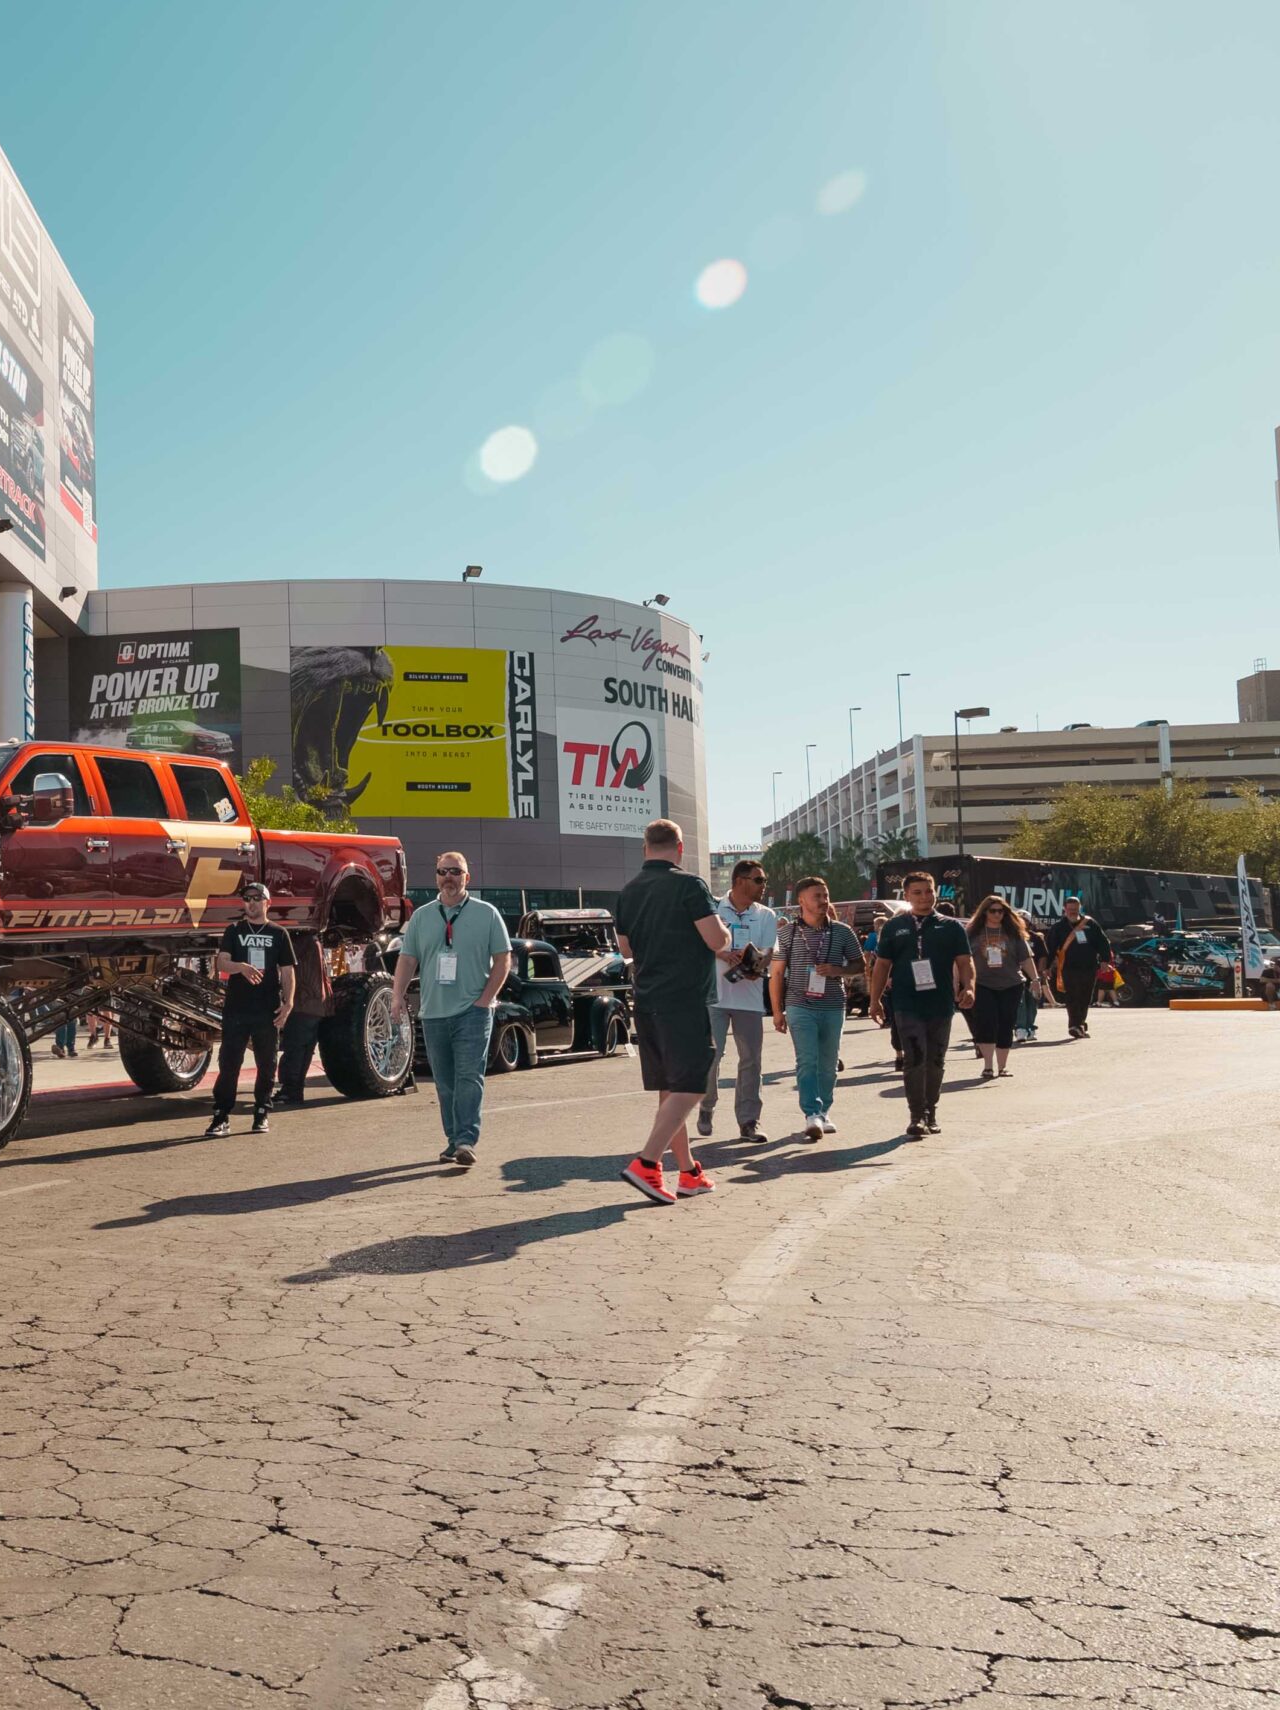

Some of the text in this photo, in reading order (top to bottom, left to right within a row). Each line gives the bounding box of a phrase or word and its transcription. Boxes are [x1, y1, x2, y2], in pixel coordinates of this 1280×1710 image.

[137, 641, 190, 660] OPTIMA
[560, 615, 691, 671] Las Vegas
[89, 663, 220, 703] POWER UP
[604, 677, 668, 713] SOUTH
[90, 692, 220, 719] AT THE BRONZE LOT
[381, 723, 495, 738] TOOLBOX
[513, 651, 535, 819] CARLYLE
[563, 741, 645, 791] TIA
[568, 792, 651, 805] TIRE INDUSTRY
[569, 803, 651, 815] ASSOCIATION
[569, 820, 584, 830] TIRE
[585, 821, 613, 831] SAFETY
[615, 823, 637, 833] STARTS
[8, 908, 187, 928] FITTIPALDI
[238, 934, 273, 947] VANS
